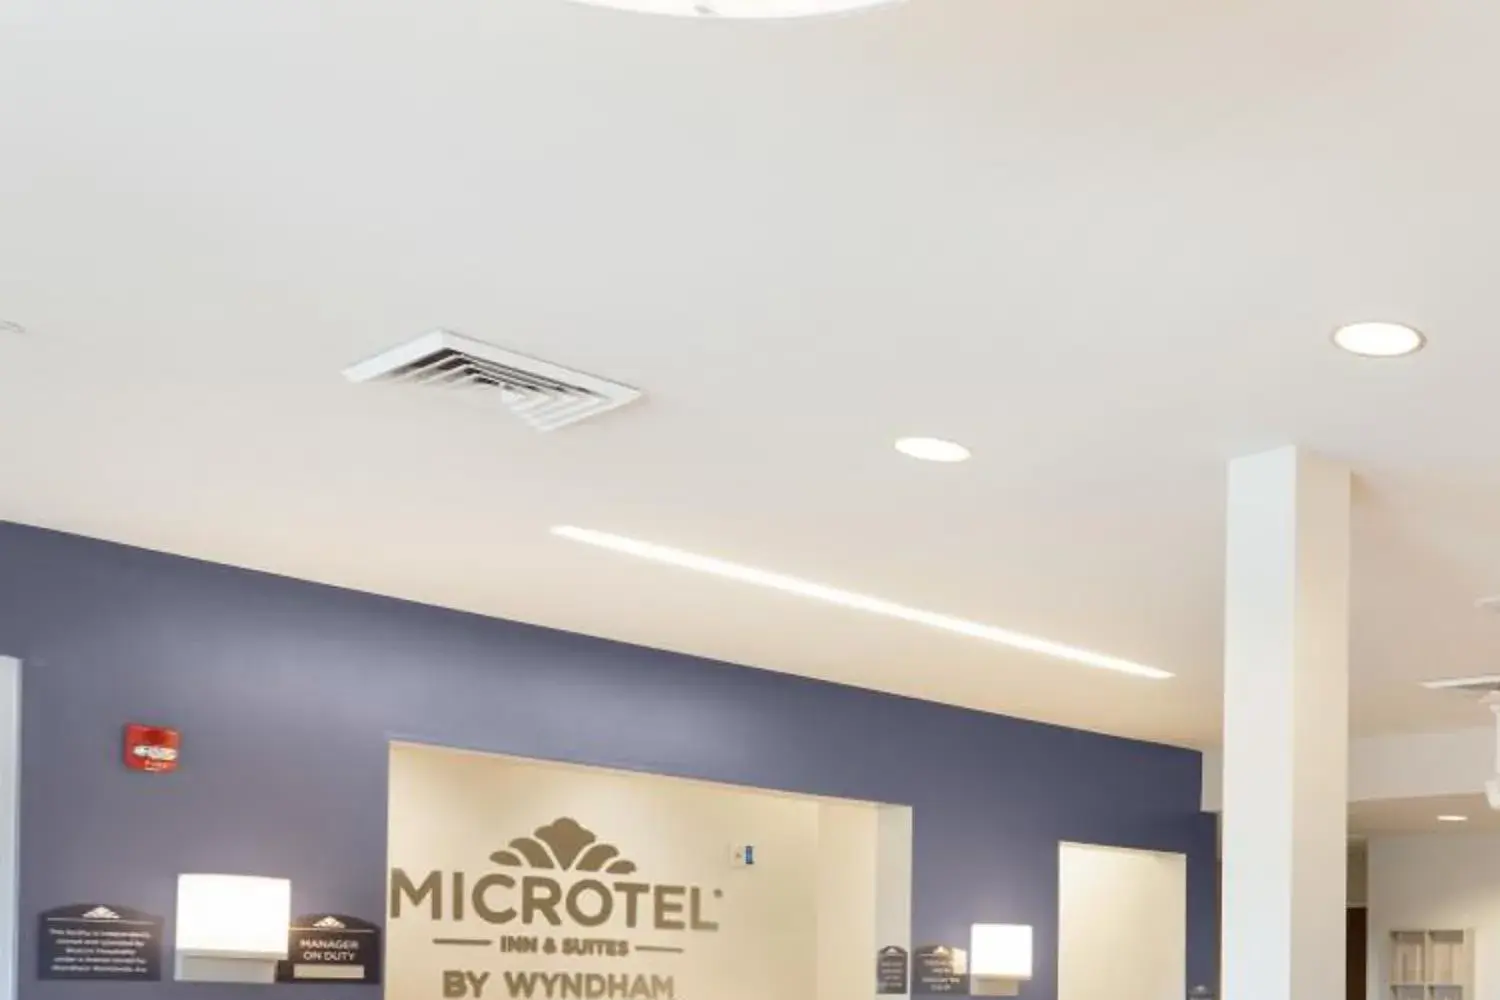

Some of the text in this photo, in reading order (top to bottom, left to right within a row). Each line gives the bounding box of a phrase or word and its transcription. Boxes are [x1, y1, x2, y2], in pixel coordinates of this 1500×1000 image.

[389, 867, 719, 932] MICROTEL
[300, 938, 359, 950] MANAGER
[500, 935, 630, 957] INN & SUITES
[303, 951, 356, 961] ON DUTY
[442, 970, 675, 1000] BY WYNDHAM
